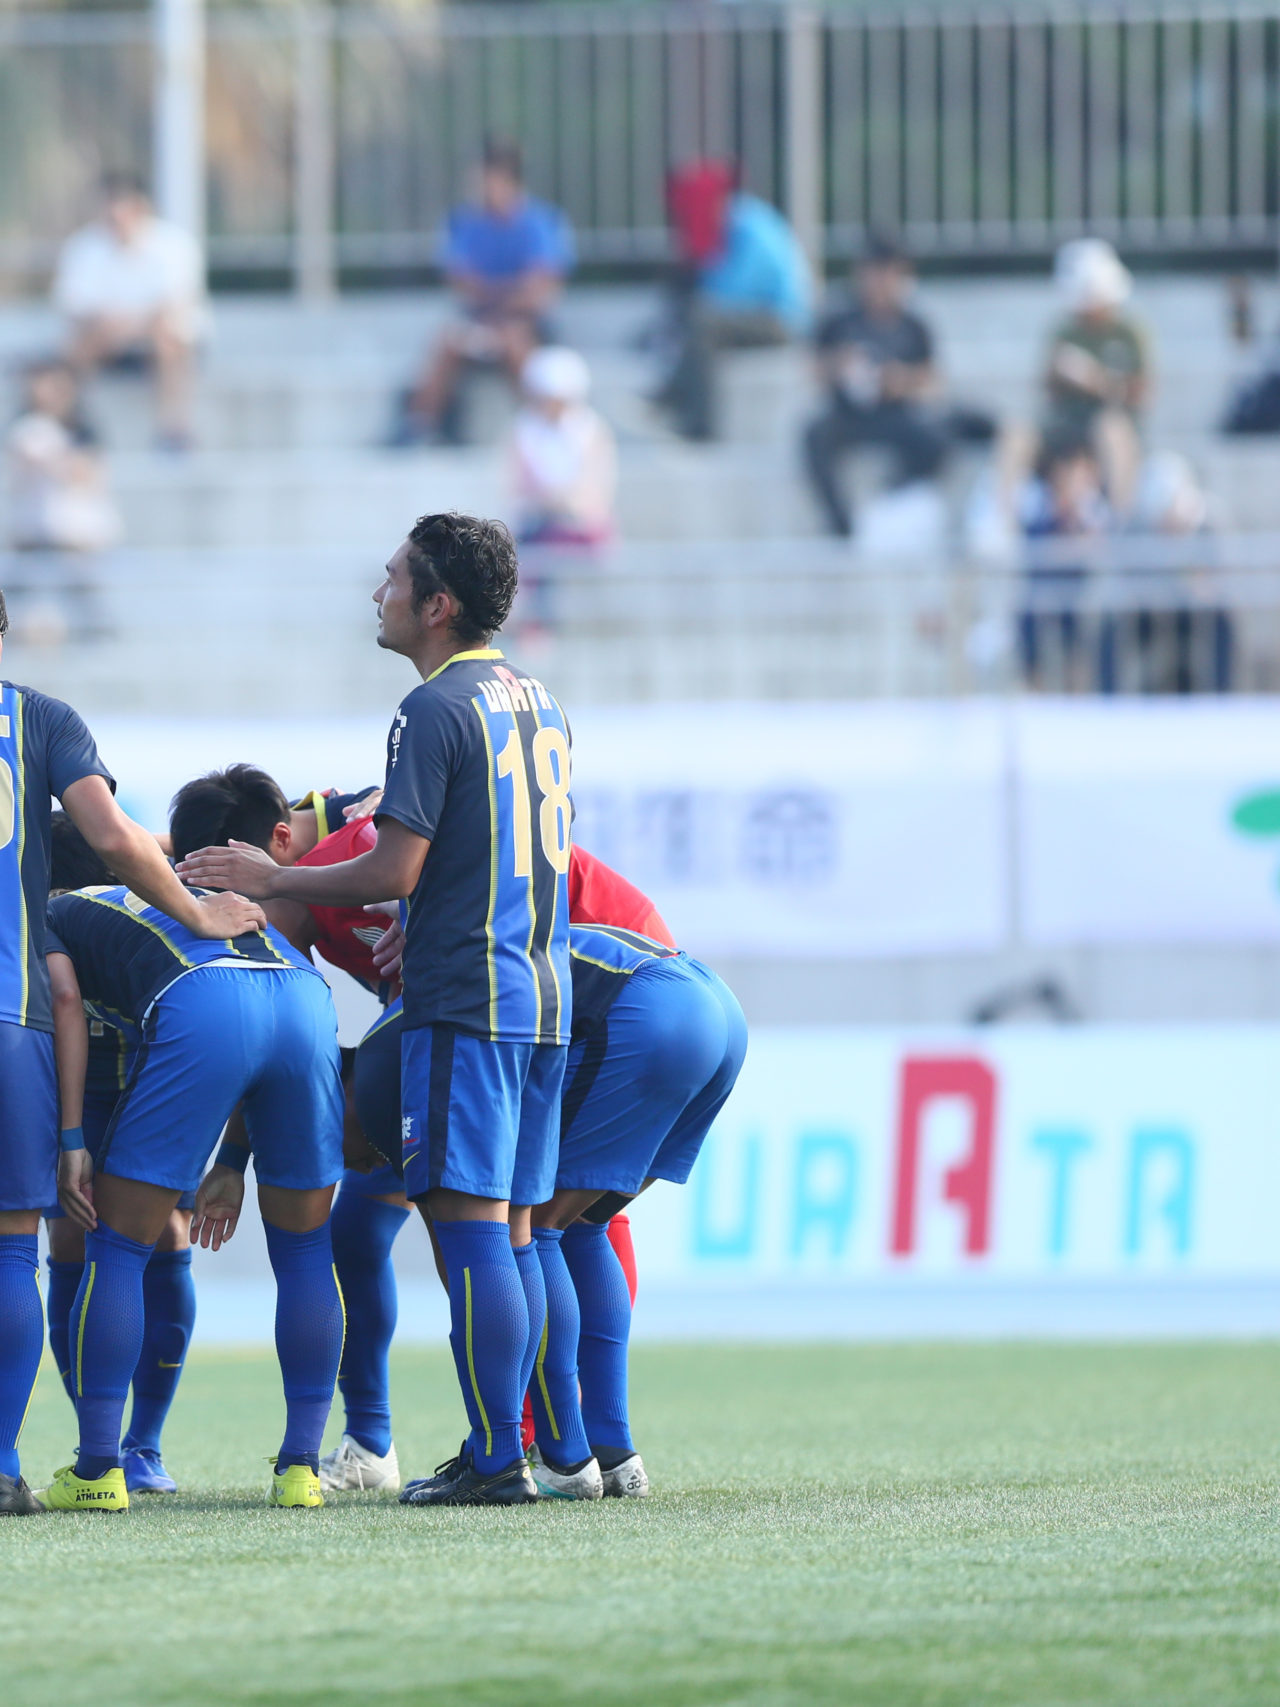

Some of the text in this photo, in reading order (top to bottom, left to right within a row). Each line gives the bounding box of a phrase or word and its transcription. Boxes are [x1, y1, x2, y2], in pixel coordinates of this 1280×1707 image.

[496, 726, 572, 878] 18
[688, 1052, 1198, 1260] URATA
[75, 1490, 117, 1503] ATHLETA
